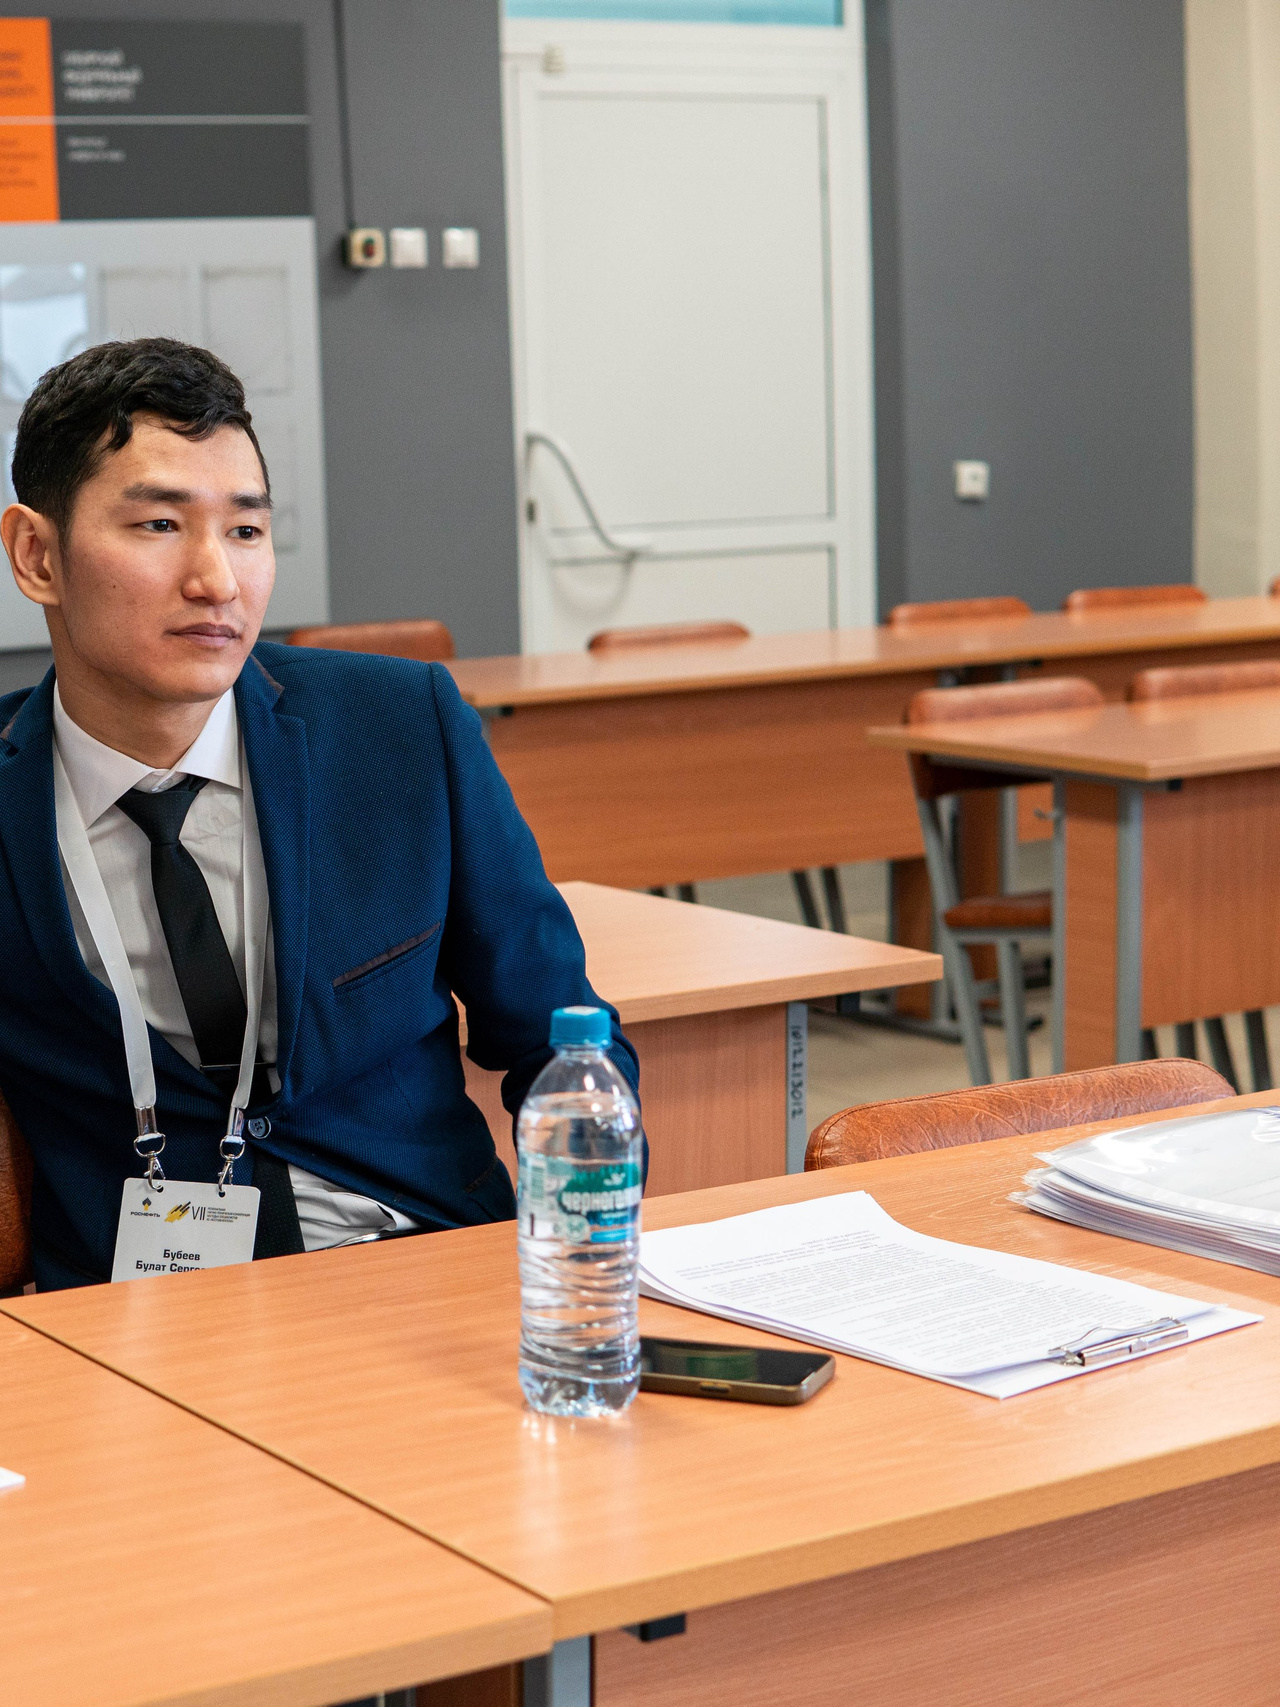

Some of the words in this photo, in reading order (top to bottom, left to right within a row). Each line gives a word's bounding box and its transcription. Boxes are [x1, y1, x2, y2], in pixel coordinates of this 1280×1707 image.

[191, 1205, 206, 1221] VII
[163, 1249, 201, 1261] Бубеев
[135, 1260, 167, 1272] Булат
